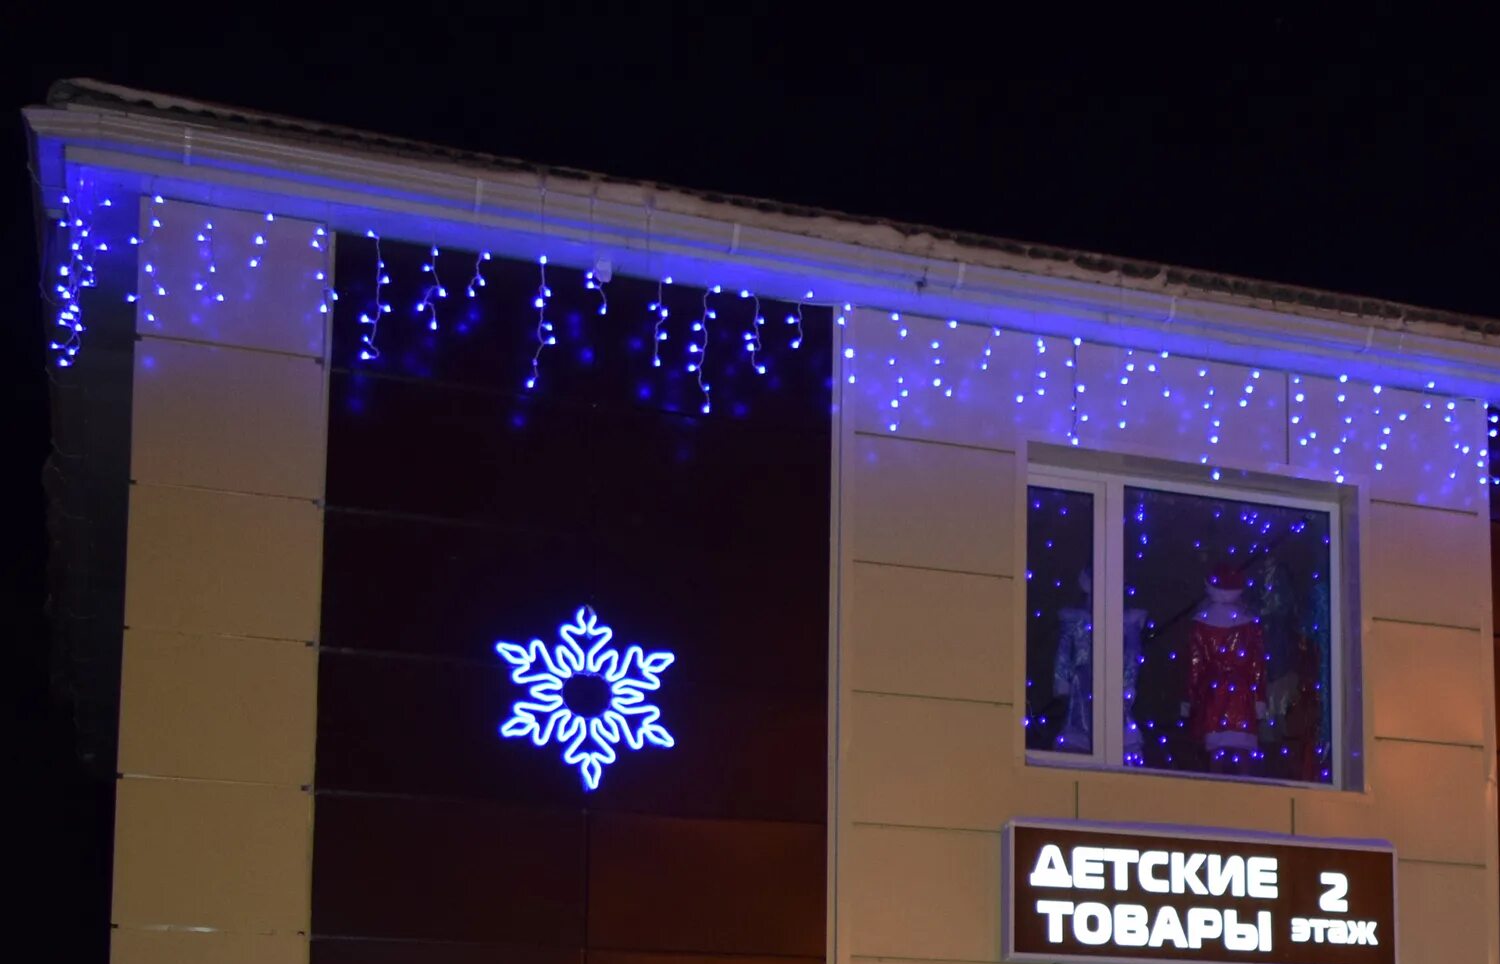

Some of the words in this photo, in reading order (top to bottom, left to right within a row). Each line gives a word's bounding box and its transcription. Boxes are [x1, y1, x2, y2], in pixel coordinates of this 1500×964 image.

[1029, 844, 1279, 899] ДЕТСКИЕ
[1319, 871, 1349, 913] 2
[1036, 899, 1273, 952] ТОВАРЫ
